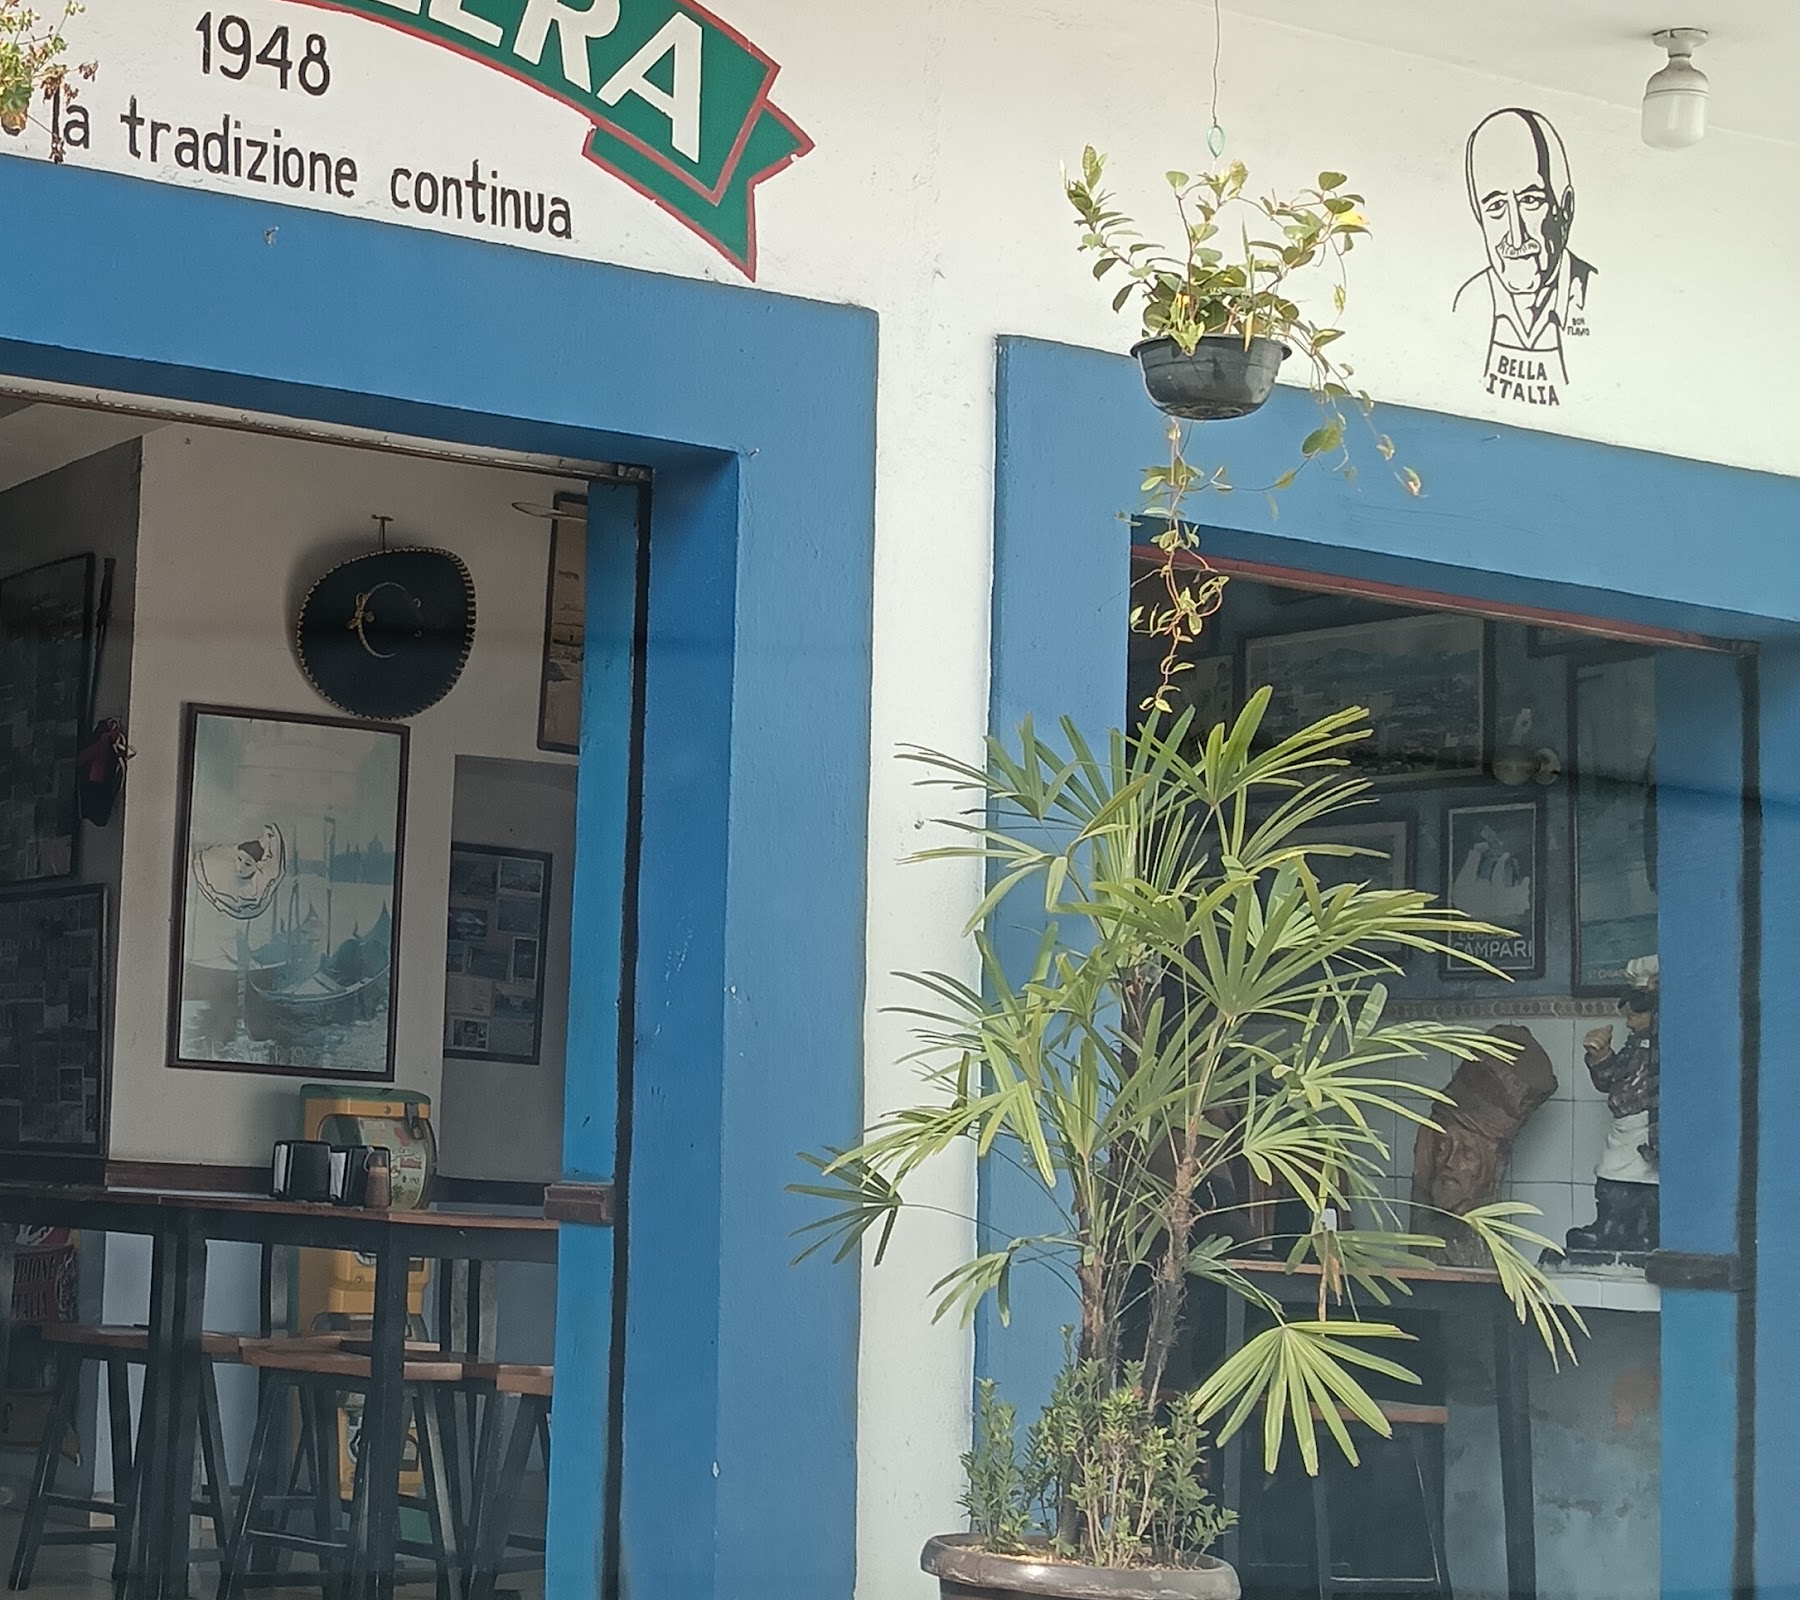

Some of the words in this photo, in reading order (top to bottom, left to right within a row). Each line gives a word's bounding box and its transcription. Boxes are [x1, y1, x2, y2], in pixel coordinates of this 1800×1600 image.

[196, 11, 331, 96] 1948
[50, 81, 91, 150] la
[120, 95, 358, 200] tradizione
[390, 158, 574, 240] continua
[1486, 373, 1560, 406] ITALIA
[1497, 355, 1548, 382] BELLA
